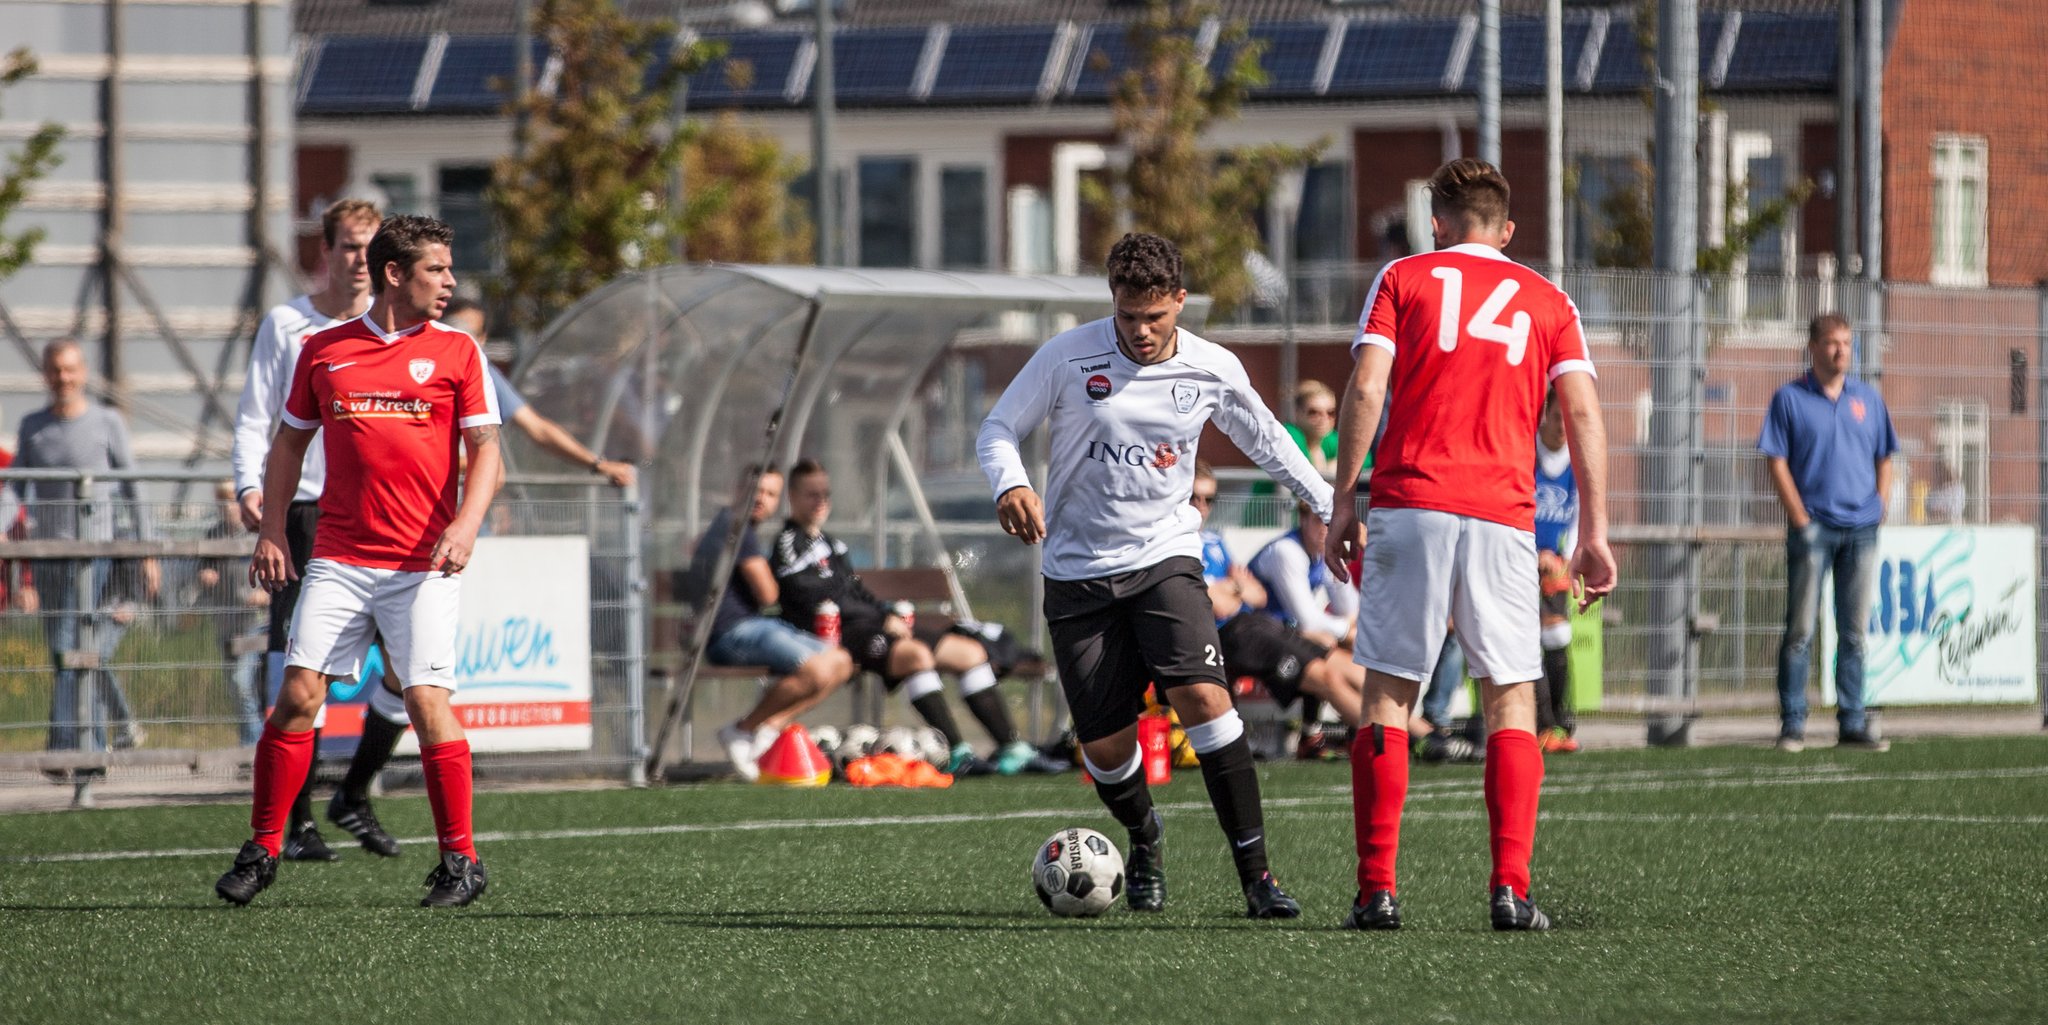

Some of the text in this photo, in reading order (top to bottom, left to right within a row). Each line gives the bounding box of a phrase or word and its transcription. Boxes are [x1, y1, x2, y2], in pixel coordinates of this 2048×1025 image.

[1430, 265, 1532, 367] 14
[1080, 361, 1111, 374] hummel
[350, 398, 371, 412] vd
[374, 399, 432, 413] Kreeke
[1086, 440, 1145, 467] ING
